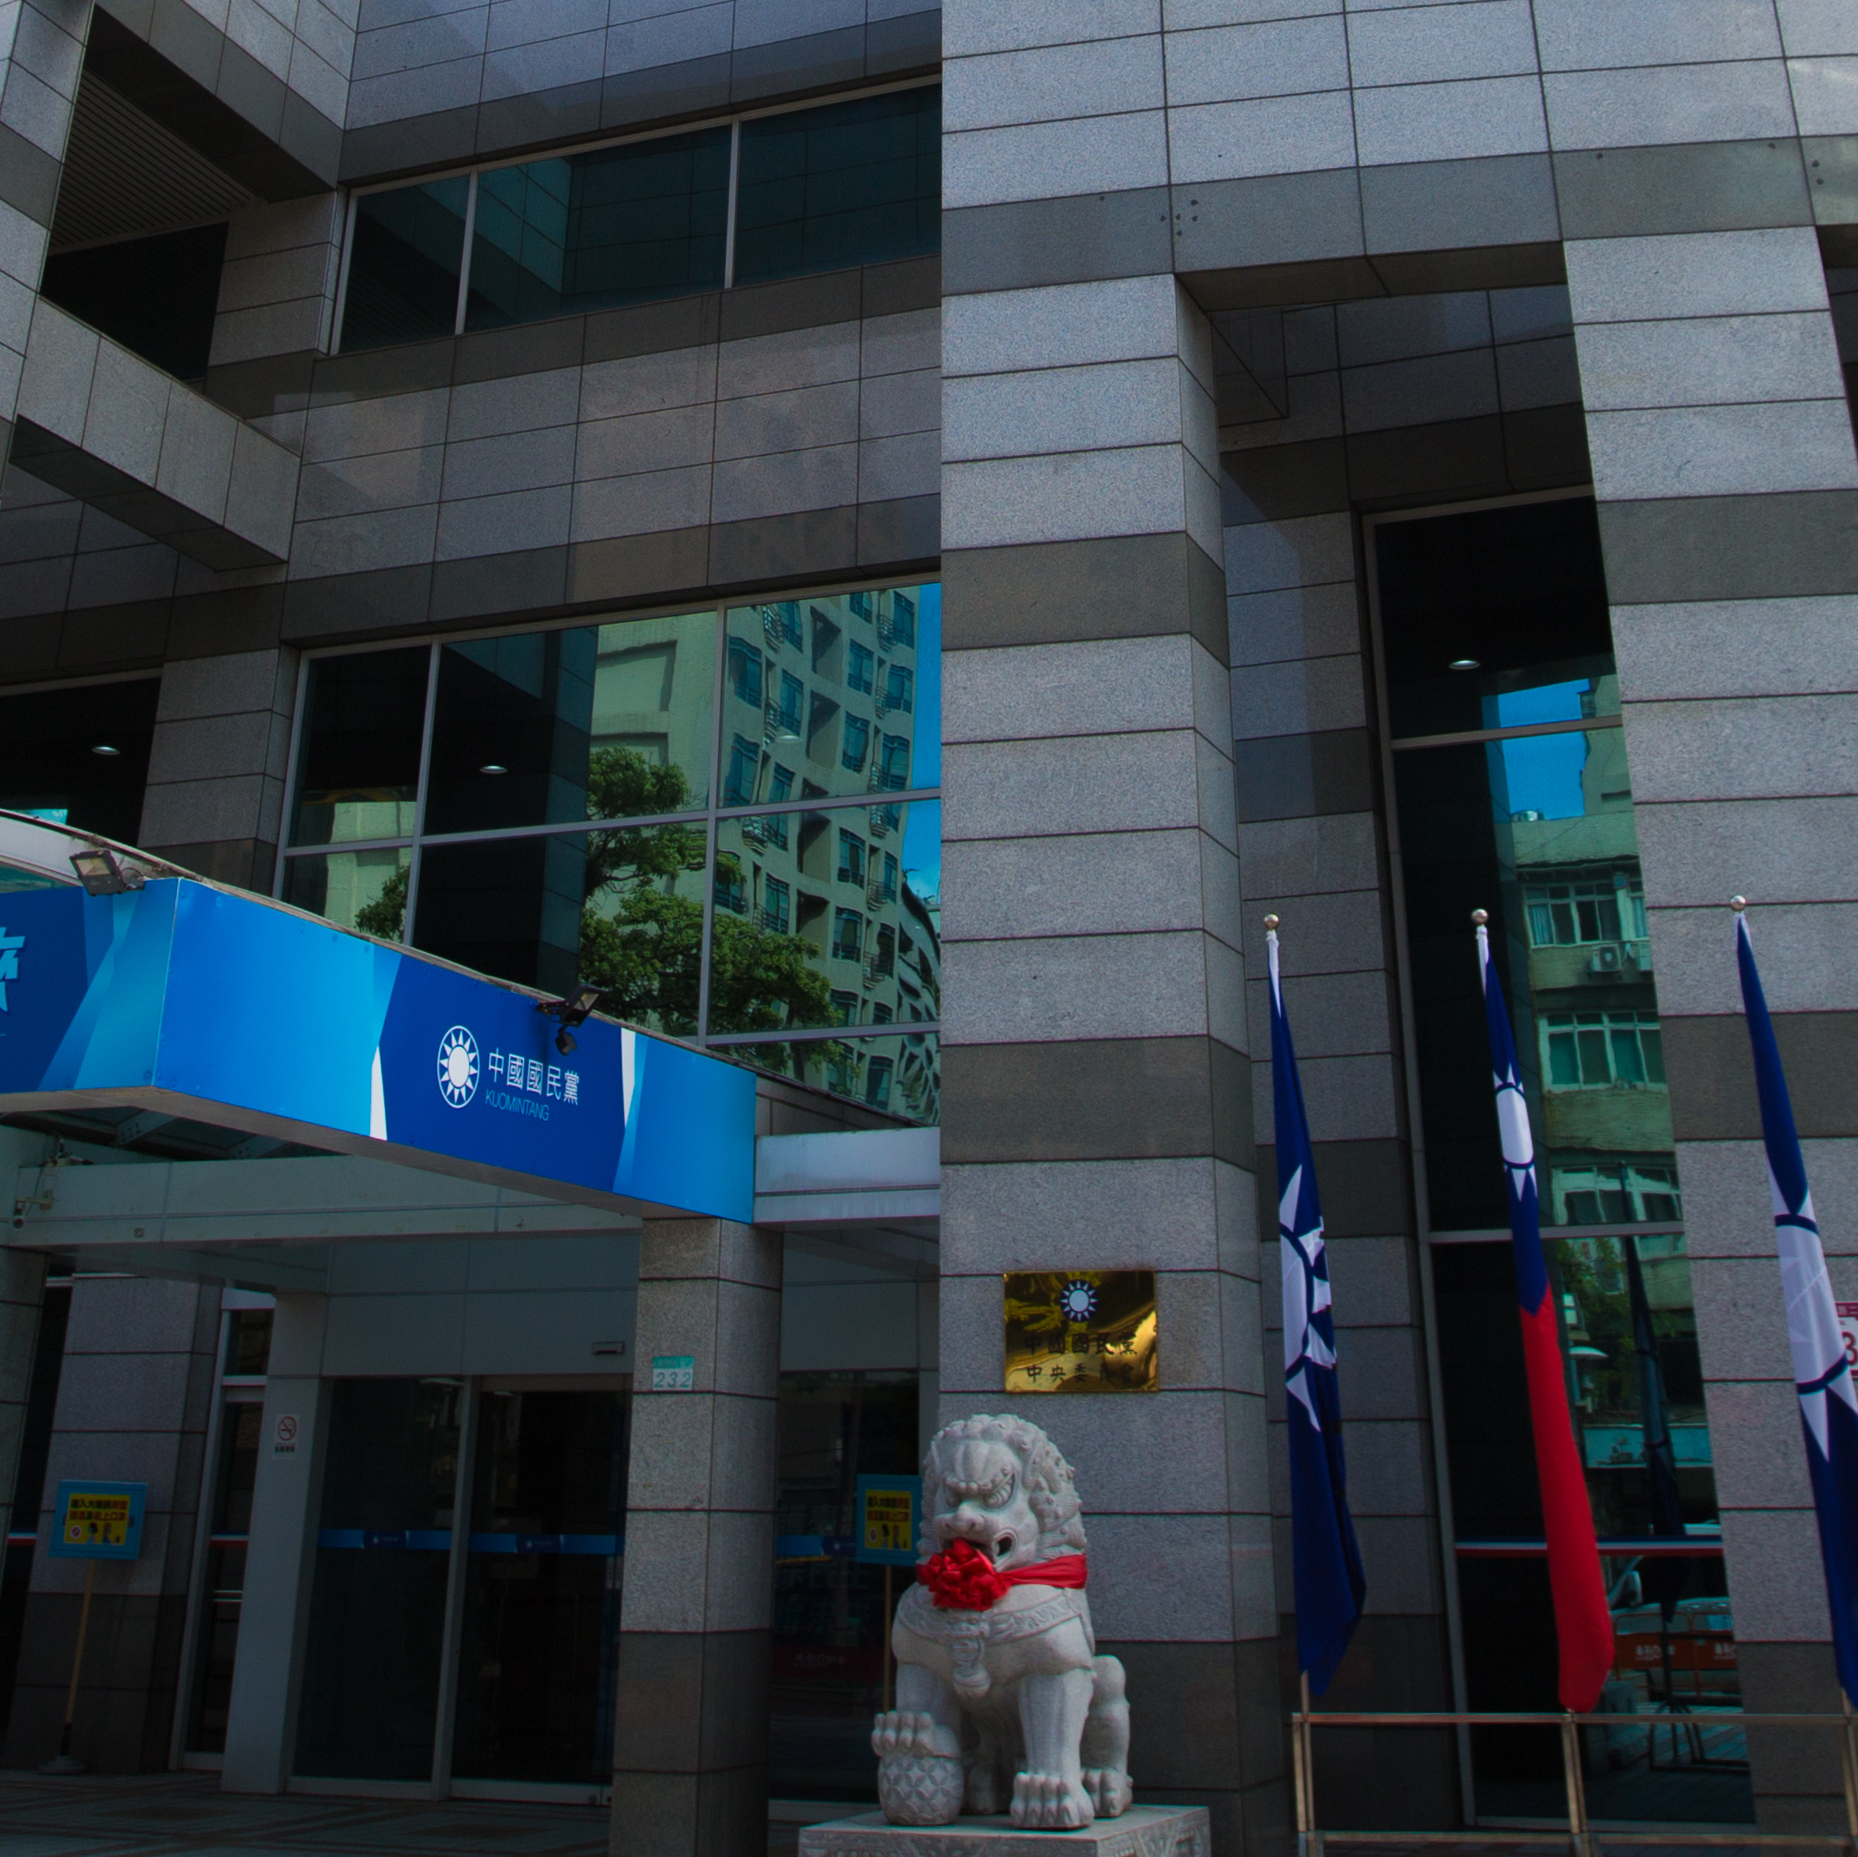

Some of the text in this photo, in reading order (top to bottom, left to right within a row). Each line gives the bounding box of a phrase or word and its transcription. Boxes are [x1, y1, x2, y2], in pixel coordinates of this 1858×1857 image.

[489, 1047, 580, 1105] 中國國民黨
[486, 1090, 550, 1121] KUOMINTANG
[1024, 1333, 1137, 1356] 中國國民黨
[654, 1371, 690, 1388] 232
